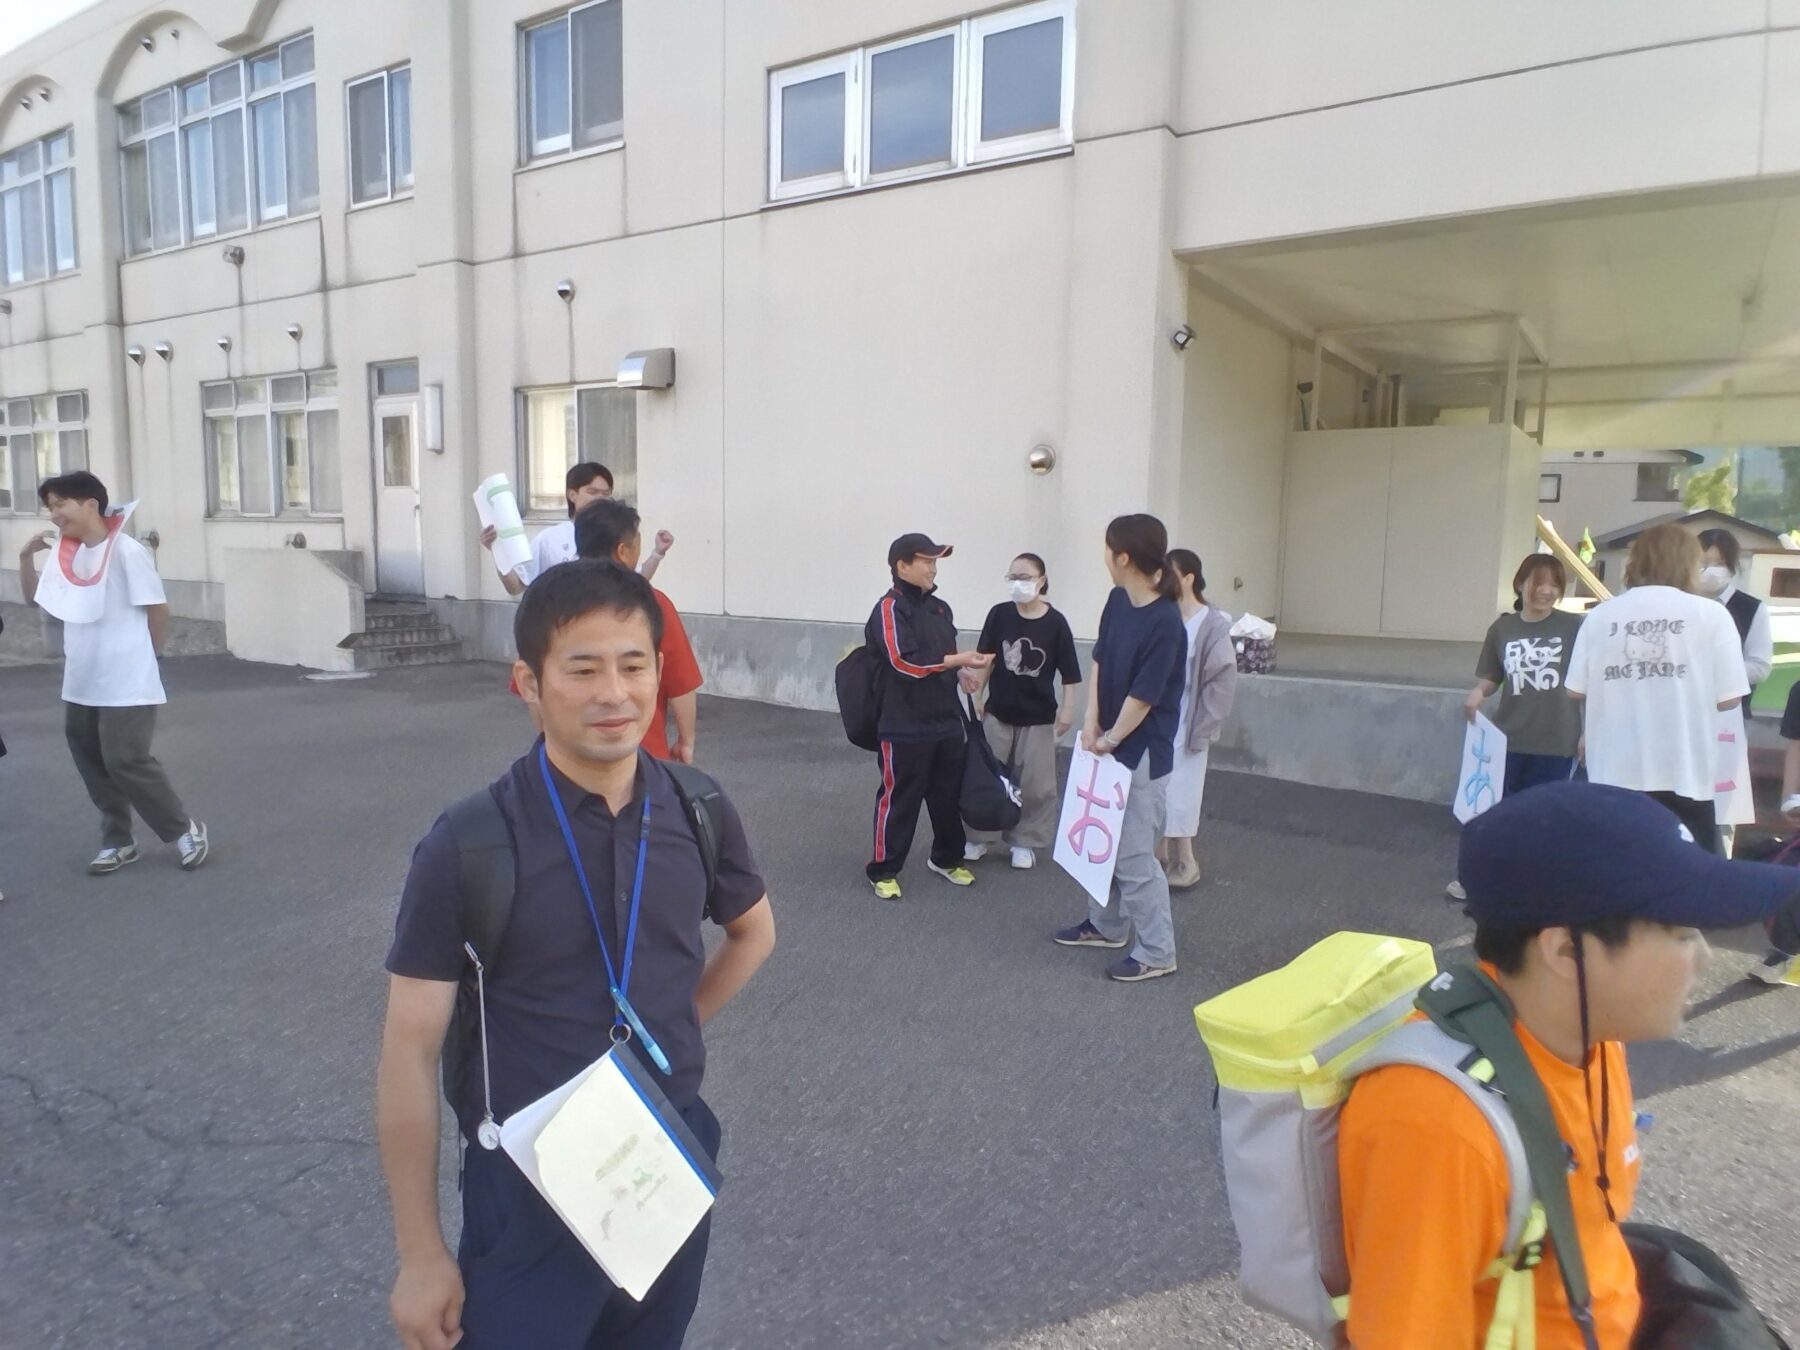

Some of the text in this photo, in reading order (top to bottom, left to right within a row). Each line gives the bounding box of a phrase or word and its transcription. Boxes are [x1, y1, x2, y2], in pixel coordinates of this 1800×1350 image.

[1608, 619, 1685, 637] I LOVE
[1604, 664, 1634, 681] ME
[1465, 728, 1496, 815] あ
[1067, 758, 1125, 864] お
